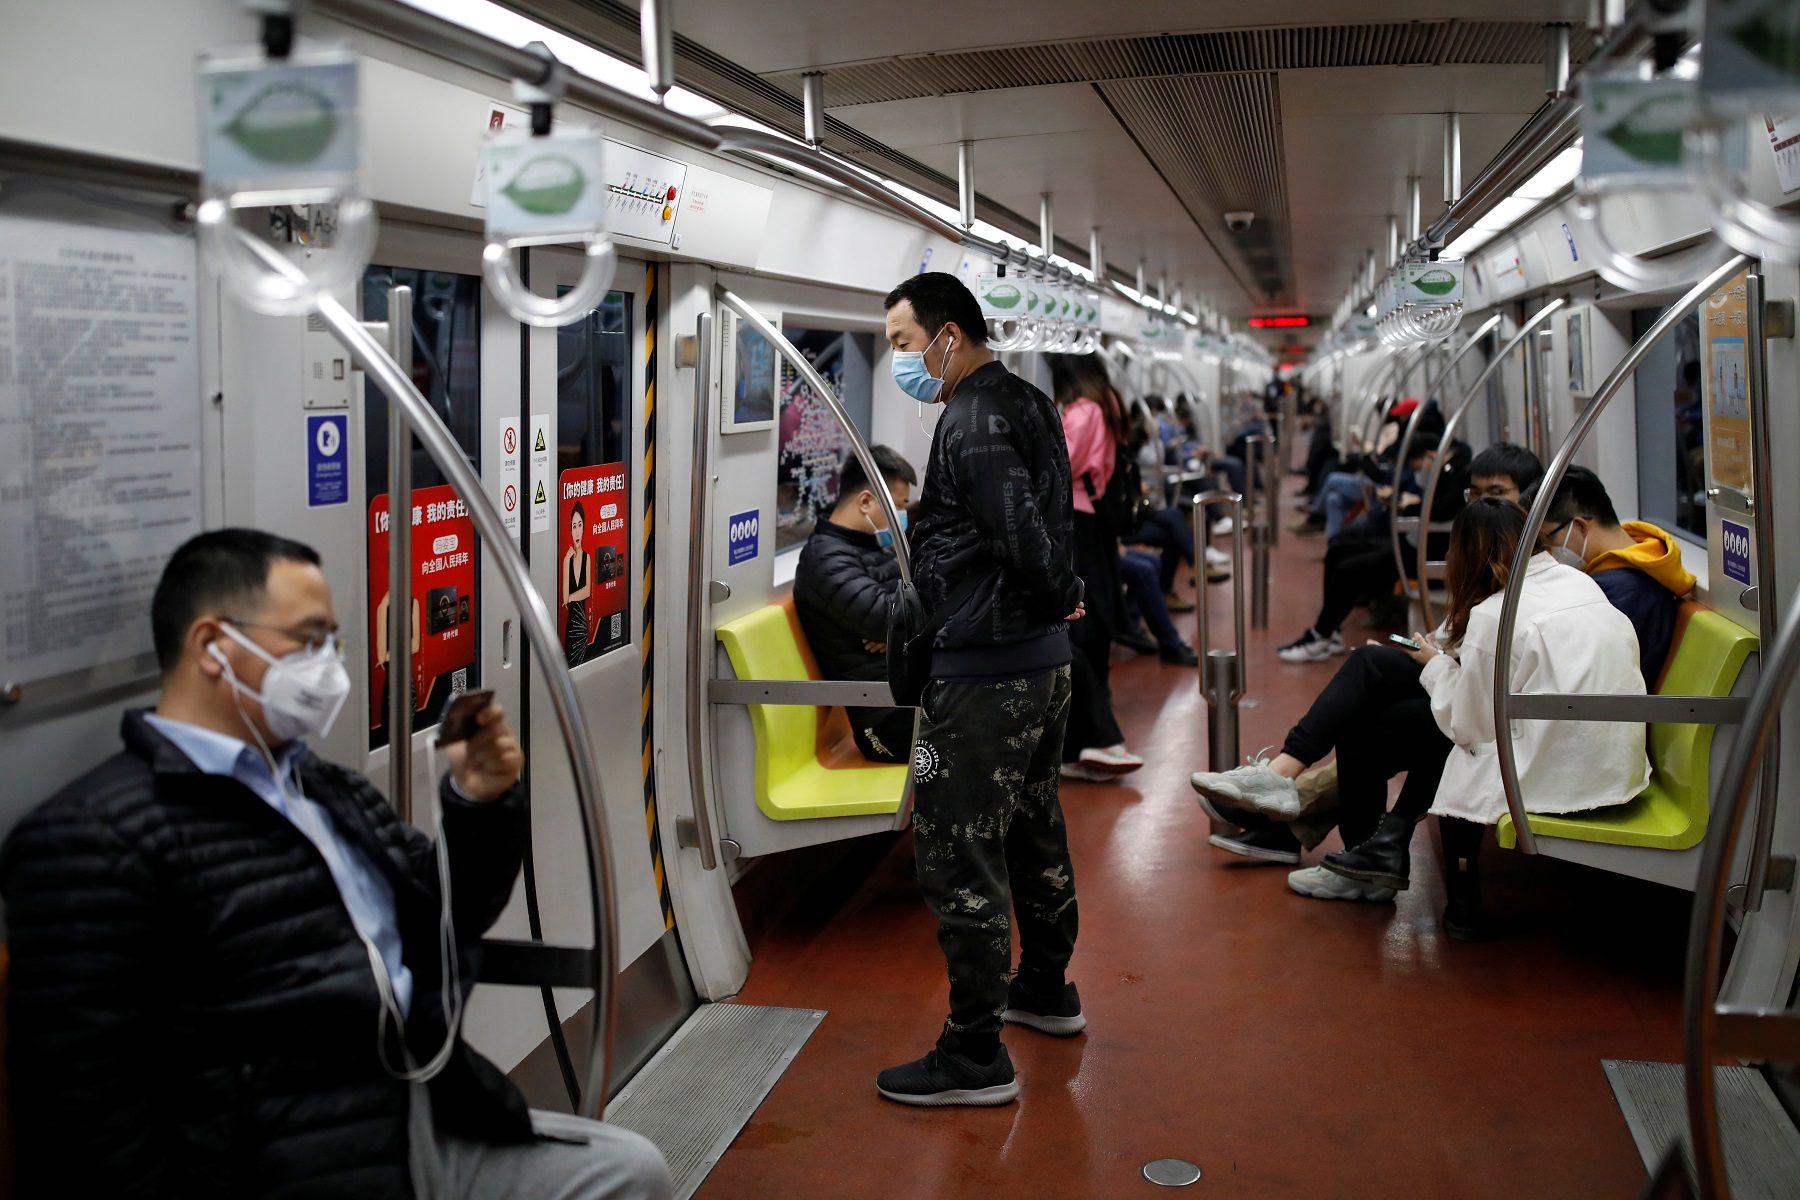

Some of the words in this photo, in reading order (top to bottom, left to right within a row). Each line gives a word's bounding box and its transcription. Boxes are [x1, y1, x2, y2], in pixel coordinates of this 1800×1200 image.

[563, 479, 594, 500] 【你的健康
[597, 473, 625, 495] 我的责任】
[374, 505, 423, 534] 【你康
[1003, 481, 1017, 531] STRIPES
[592, 518, 624, 536] 向全国人民拜年
[421, 551, 469, 576] 向全国人民拜年
